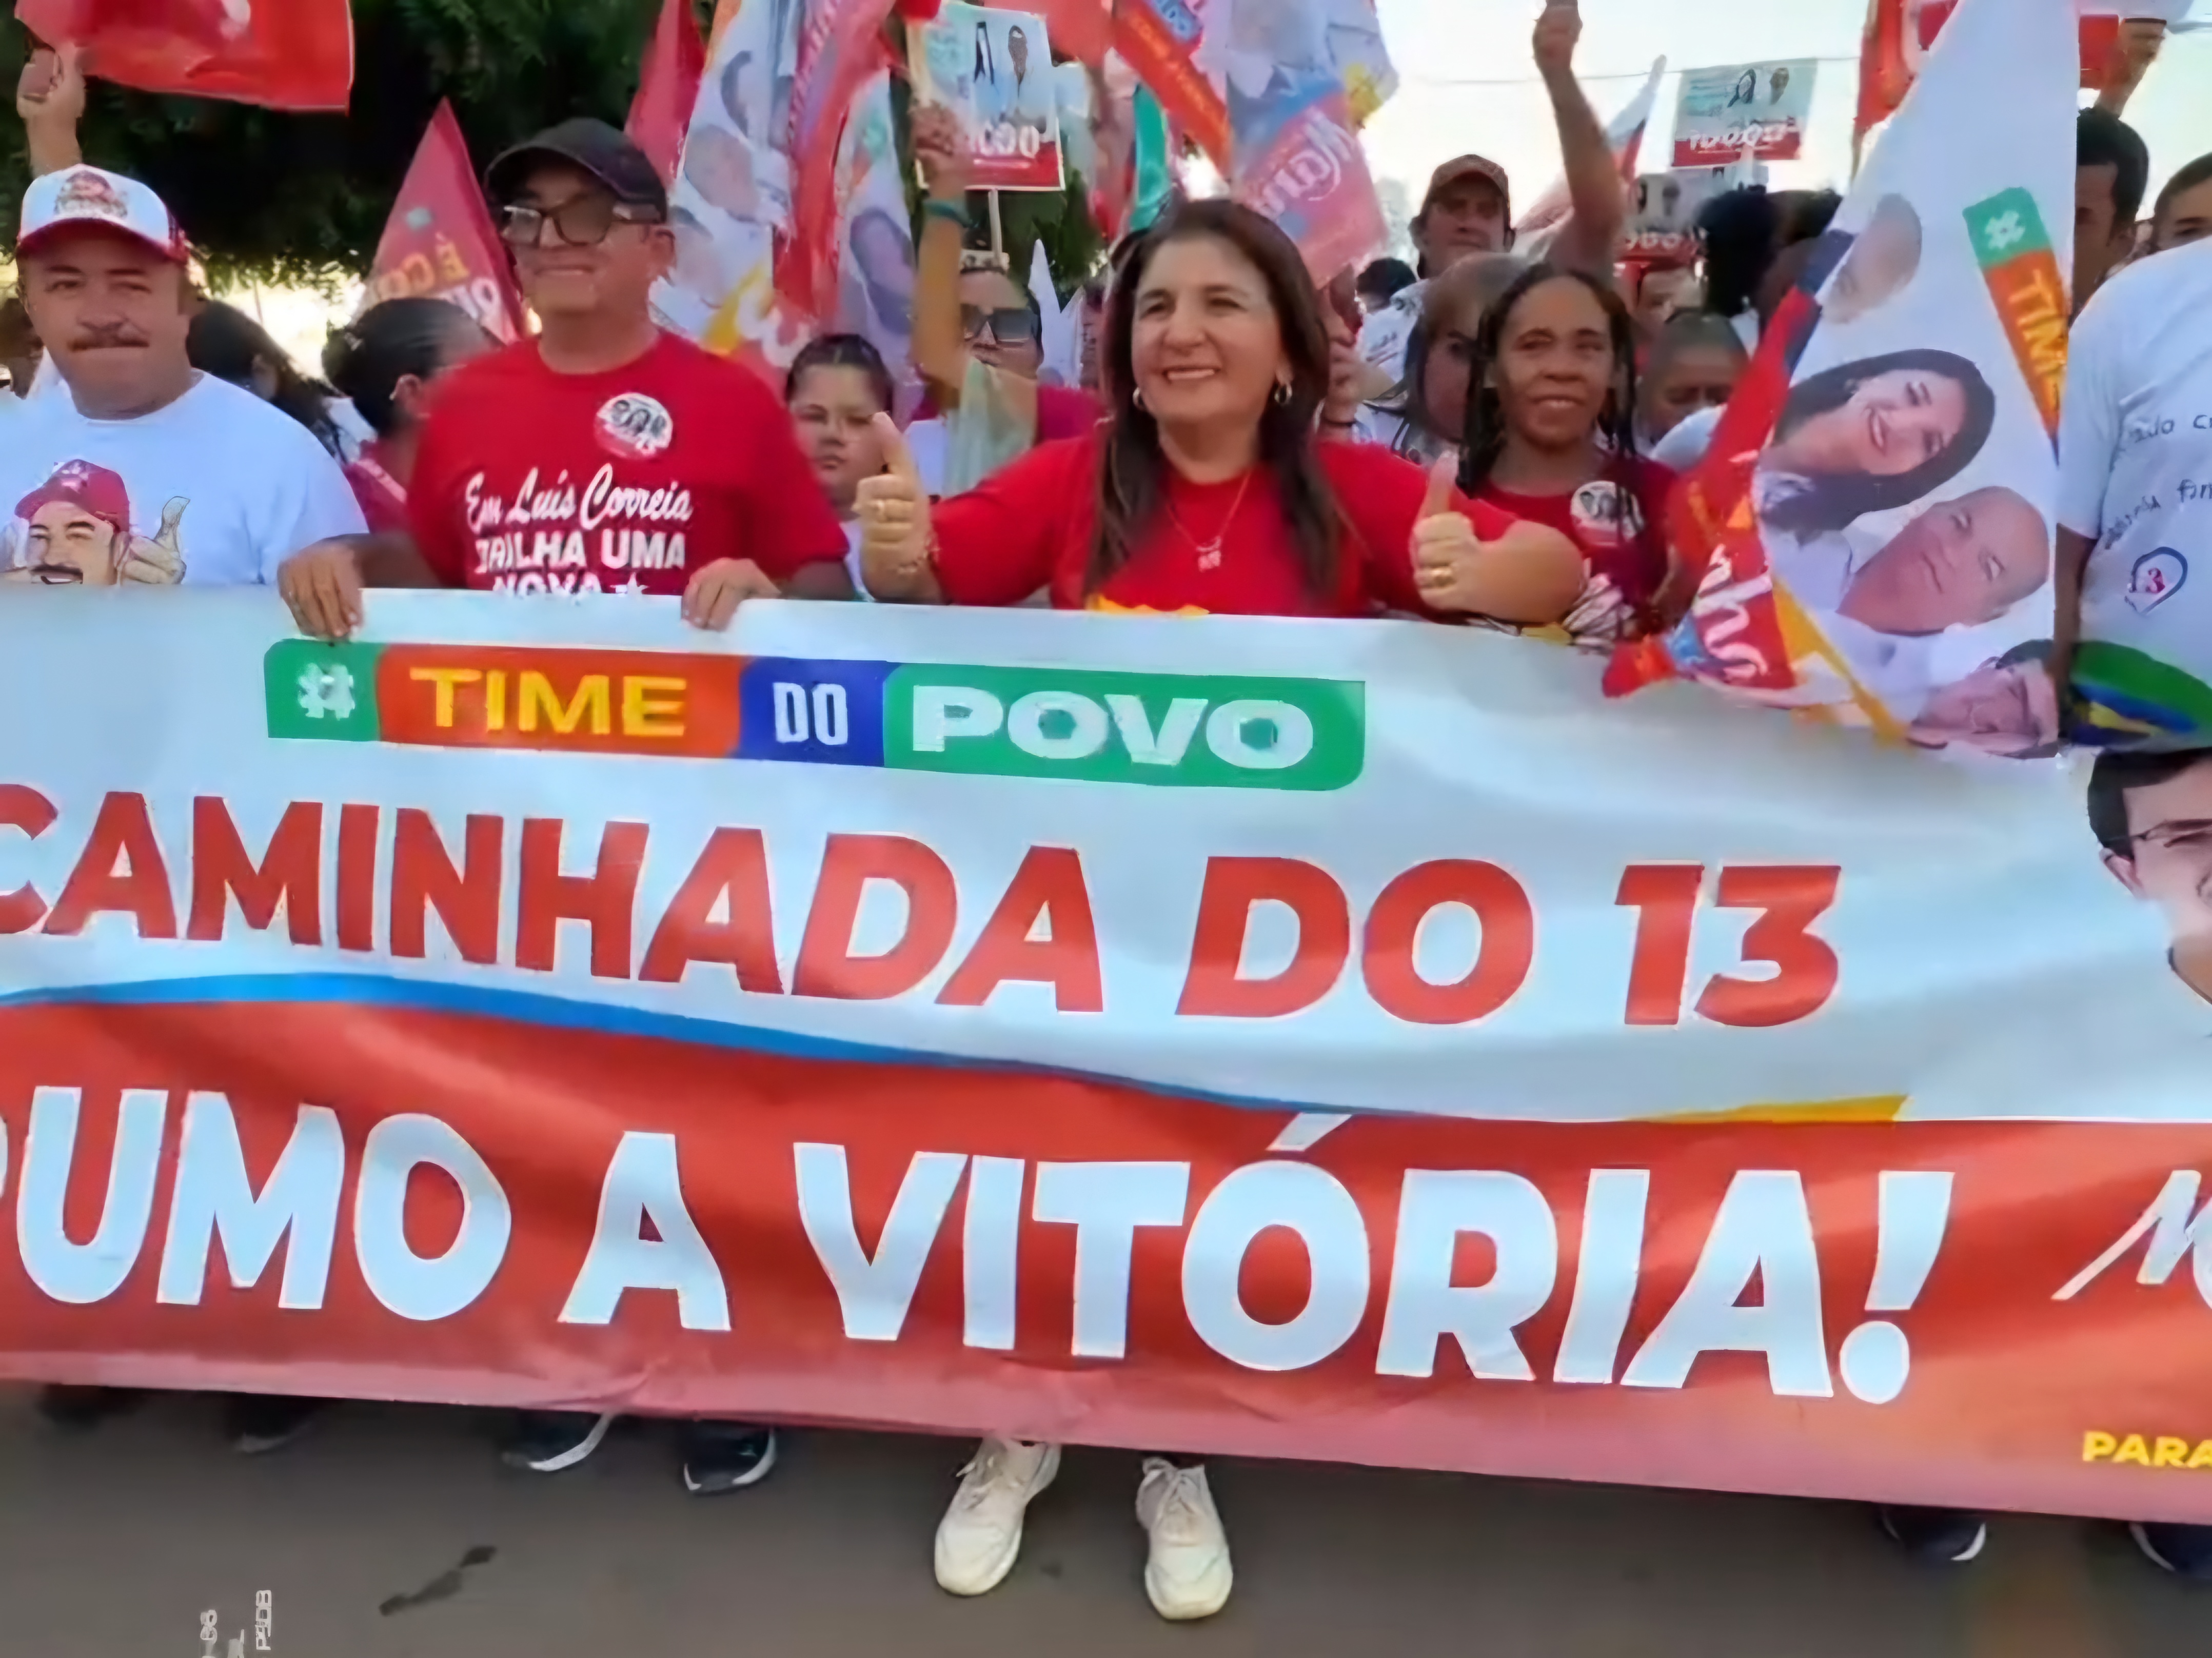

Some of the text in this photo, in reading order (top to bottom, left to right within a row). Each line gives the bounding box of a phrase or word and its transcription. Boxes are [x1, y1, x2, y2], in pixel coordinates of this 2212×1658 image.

[465, 471, 503, 534] Em
[580, 463, 694, 530] Correia
[601, 528, 686, 569] UMA
[409, 666, 686, 738] TIME
[773, 681, 850, 746] DO
[912, 684, 1314, 769] POVO
[1175, 856, 1534, 1024] DO
[1614, 864, 1842, 1027] 13
[0, 1085, 1956, 1404] UMO A VITÓRIA!
